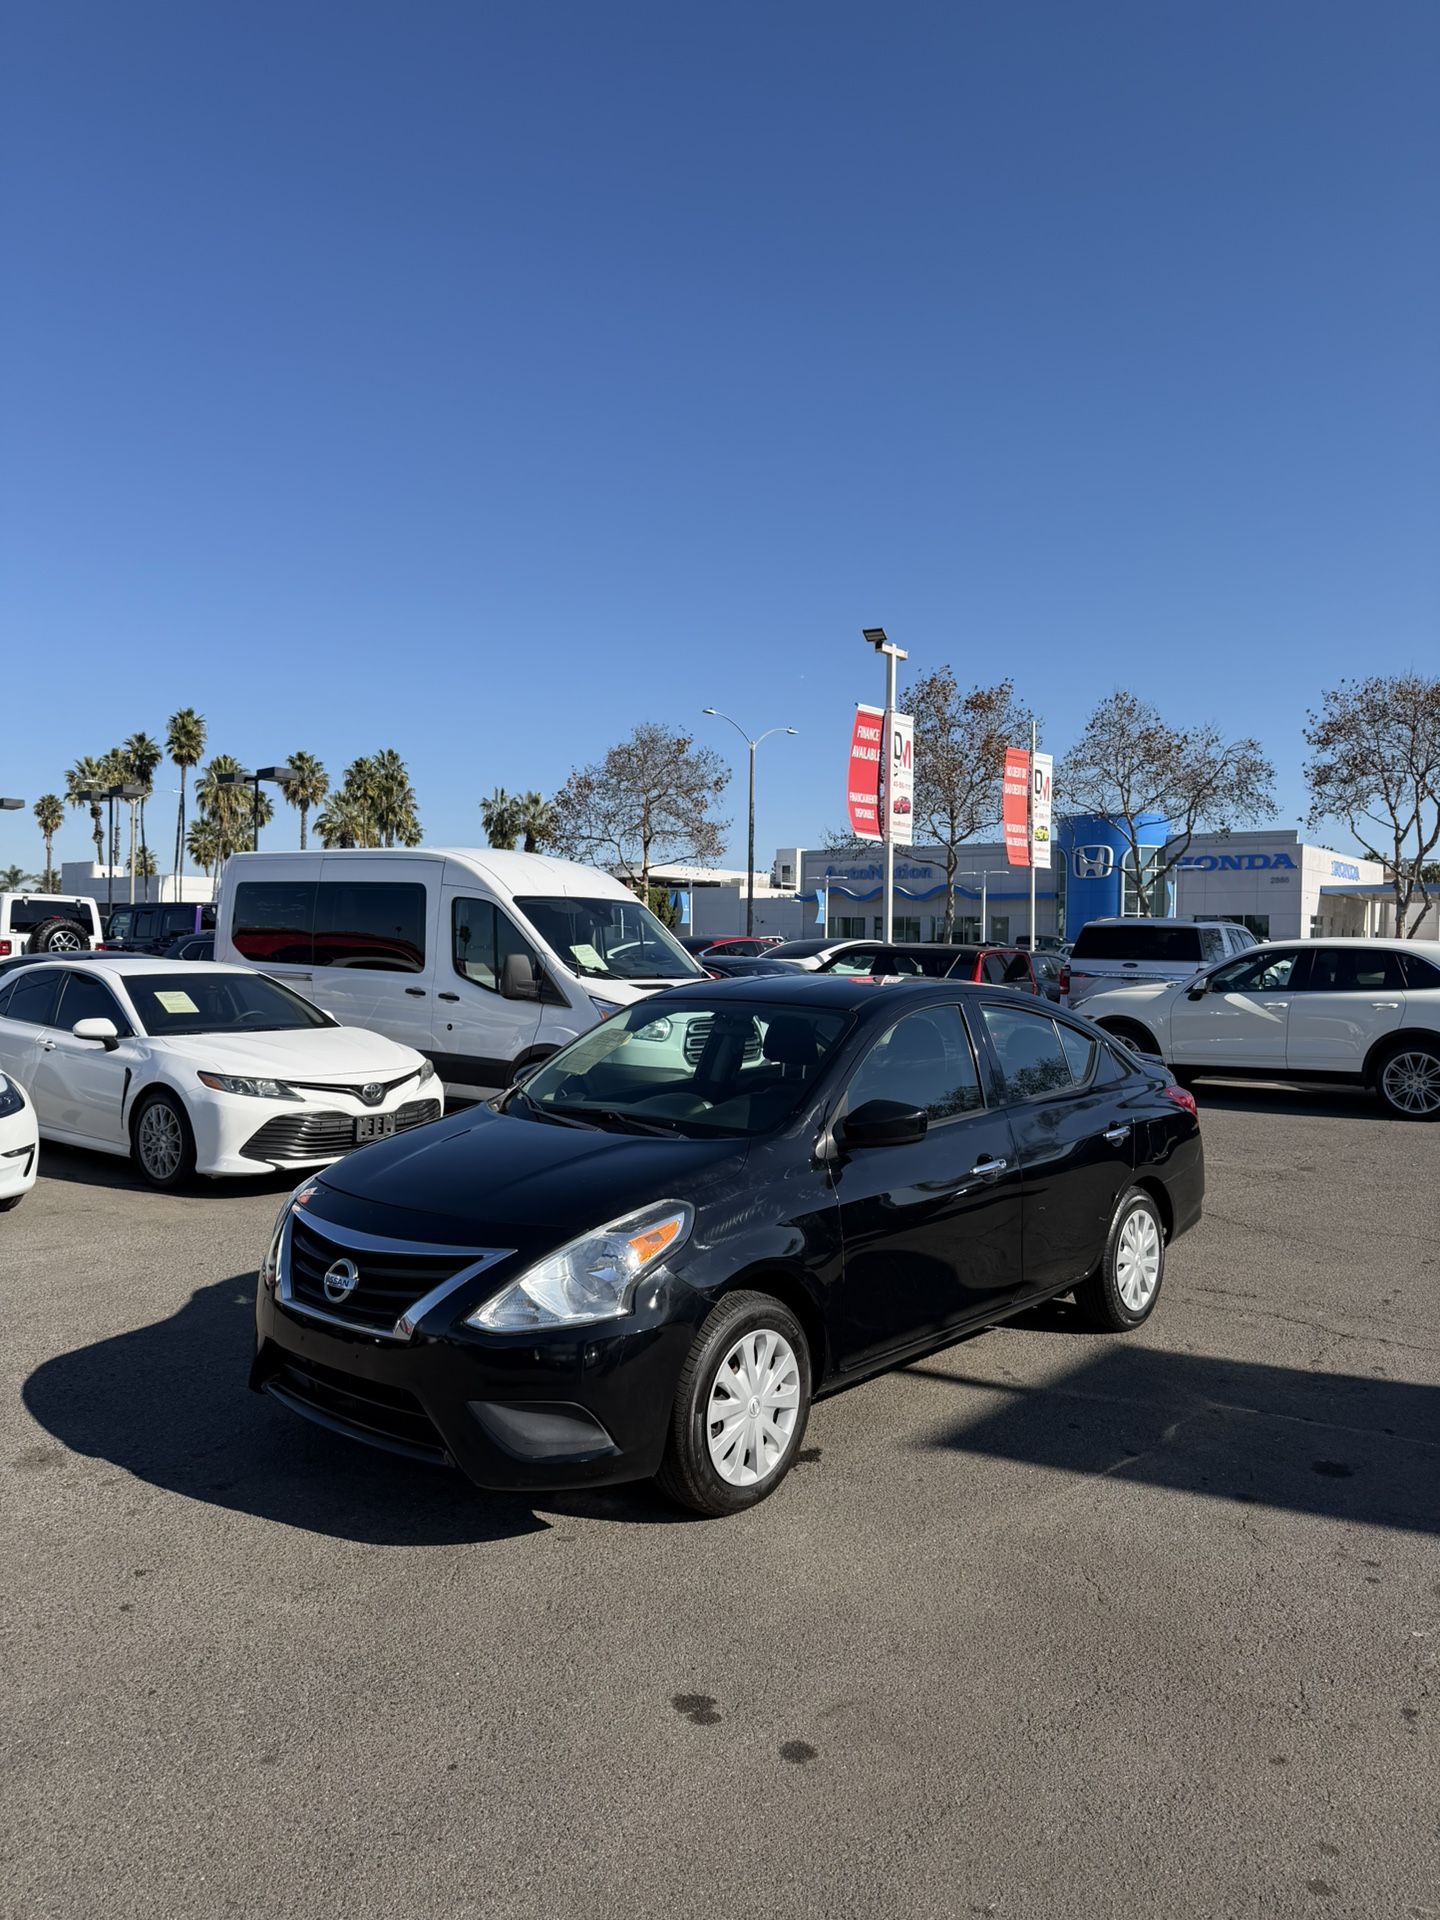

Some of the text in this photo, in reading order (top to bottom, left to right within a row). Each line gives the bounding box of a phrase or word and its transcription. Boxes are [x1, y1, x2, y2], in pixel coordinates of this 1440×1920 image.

[857, 725, 880, 742] FINANCE
[1167, 853, 1297, 872] HONDA
[825, 863, 932, 880] AutoNtion
